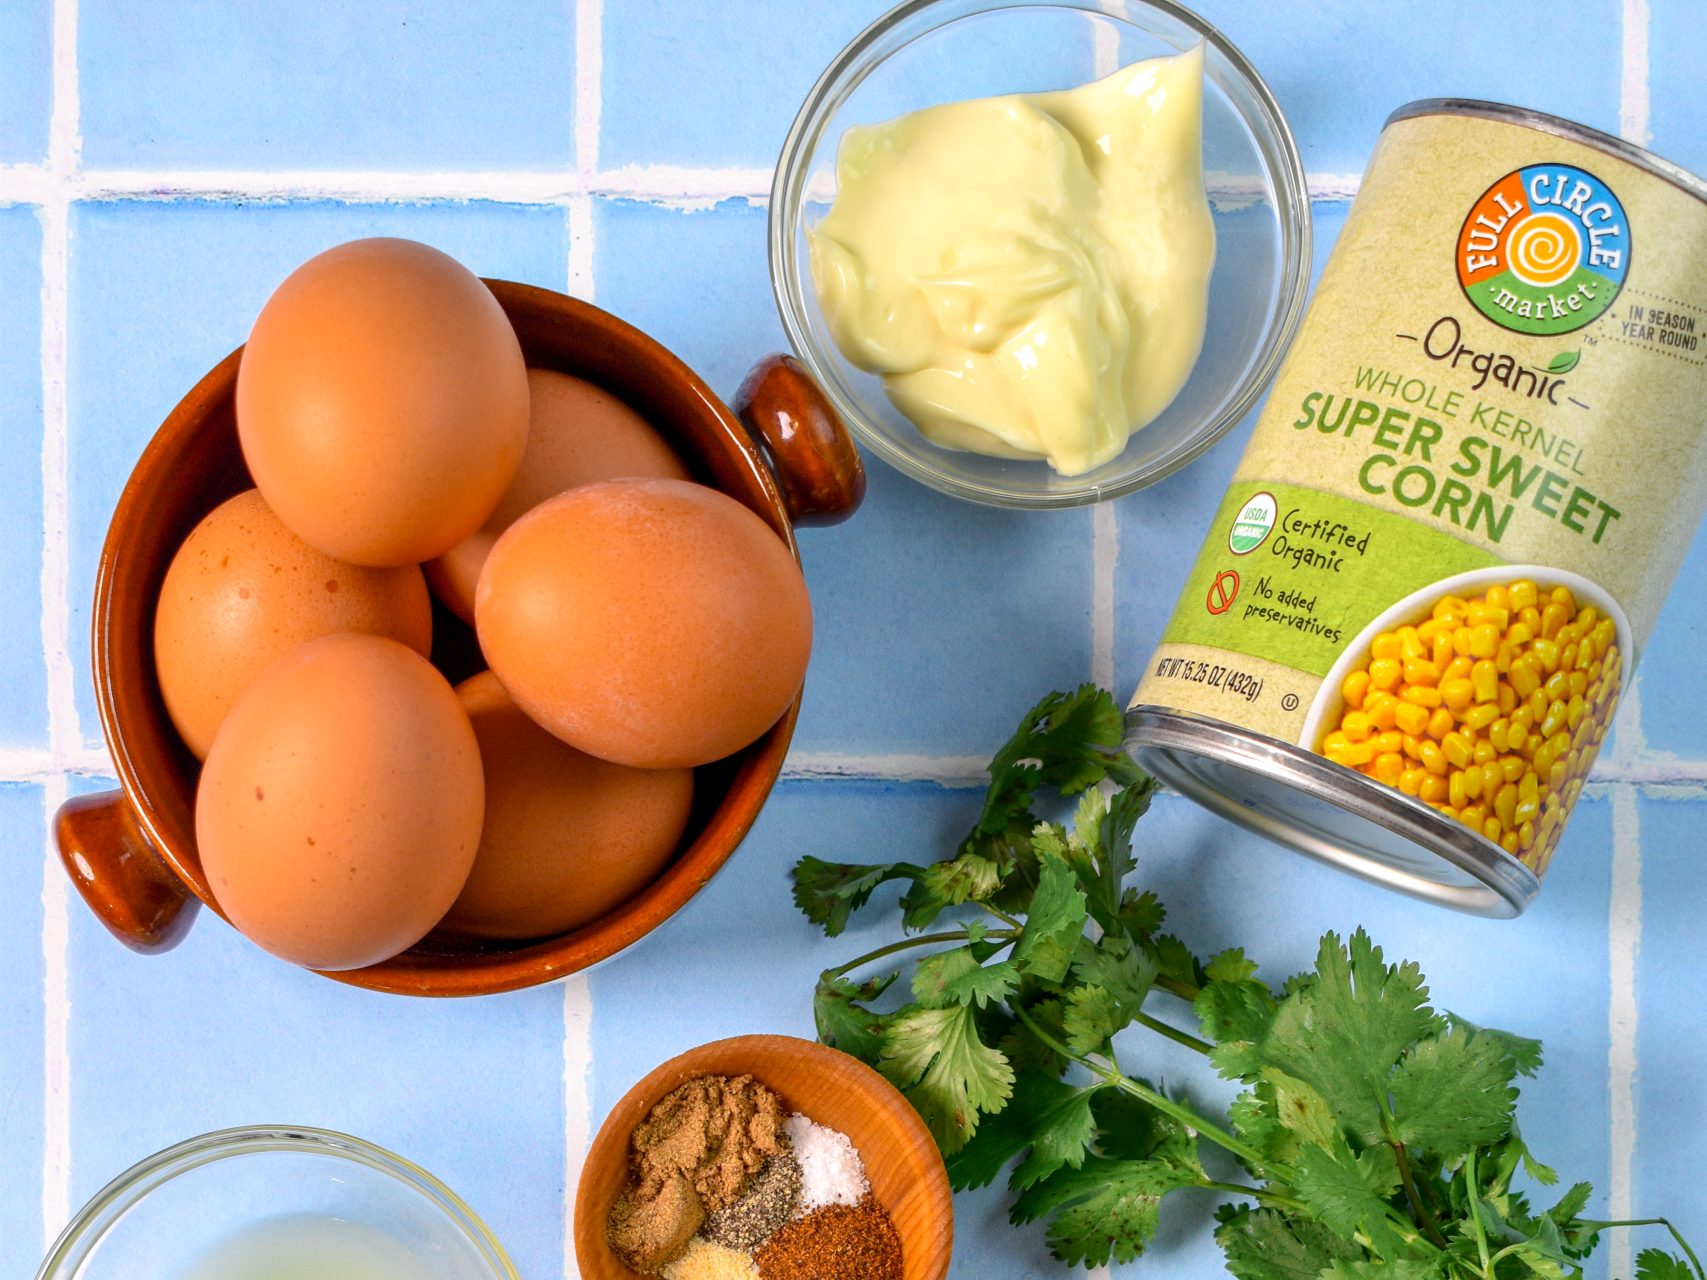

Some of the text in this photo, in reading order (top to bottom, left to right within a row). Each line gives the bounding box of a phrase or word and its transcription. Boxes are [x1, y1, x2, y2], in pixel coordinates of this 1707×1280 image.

[1466, 174, 1622, 274] FULL CIRCLE
[1493, 283, 1596, 320] market
[1629, 305, 1696, 333] IN SEASON
[1622, 321, 1698, 351] YEAR ROUND
[1423, 316, 1566, 406] Organic
[1355, 366, 1585, 475] WHOLE KERNEL
[1293, 391, 1622, 545] SUPER SWEET
[1244, 507, 1268, 522] USDA
[1357, 453, 1515, 544] CORN
[1272, 535, 1344, 572] Organic
[1282, 508, 1371, 556] Certified
[1253, 575, 1317, 614] No added
[1242, 603, 1343, 644] preservatives
[1156, 658, 1264, 704] NET WT 15.25 OZ (432g)
